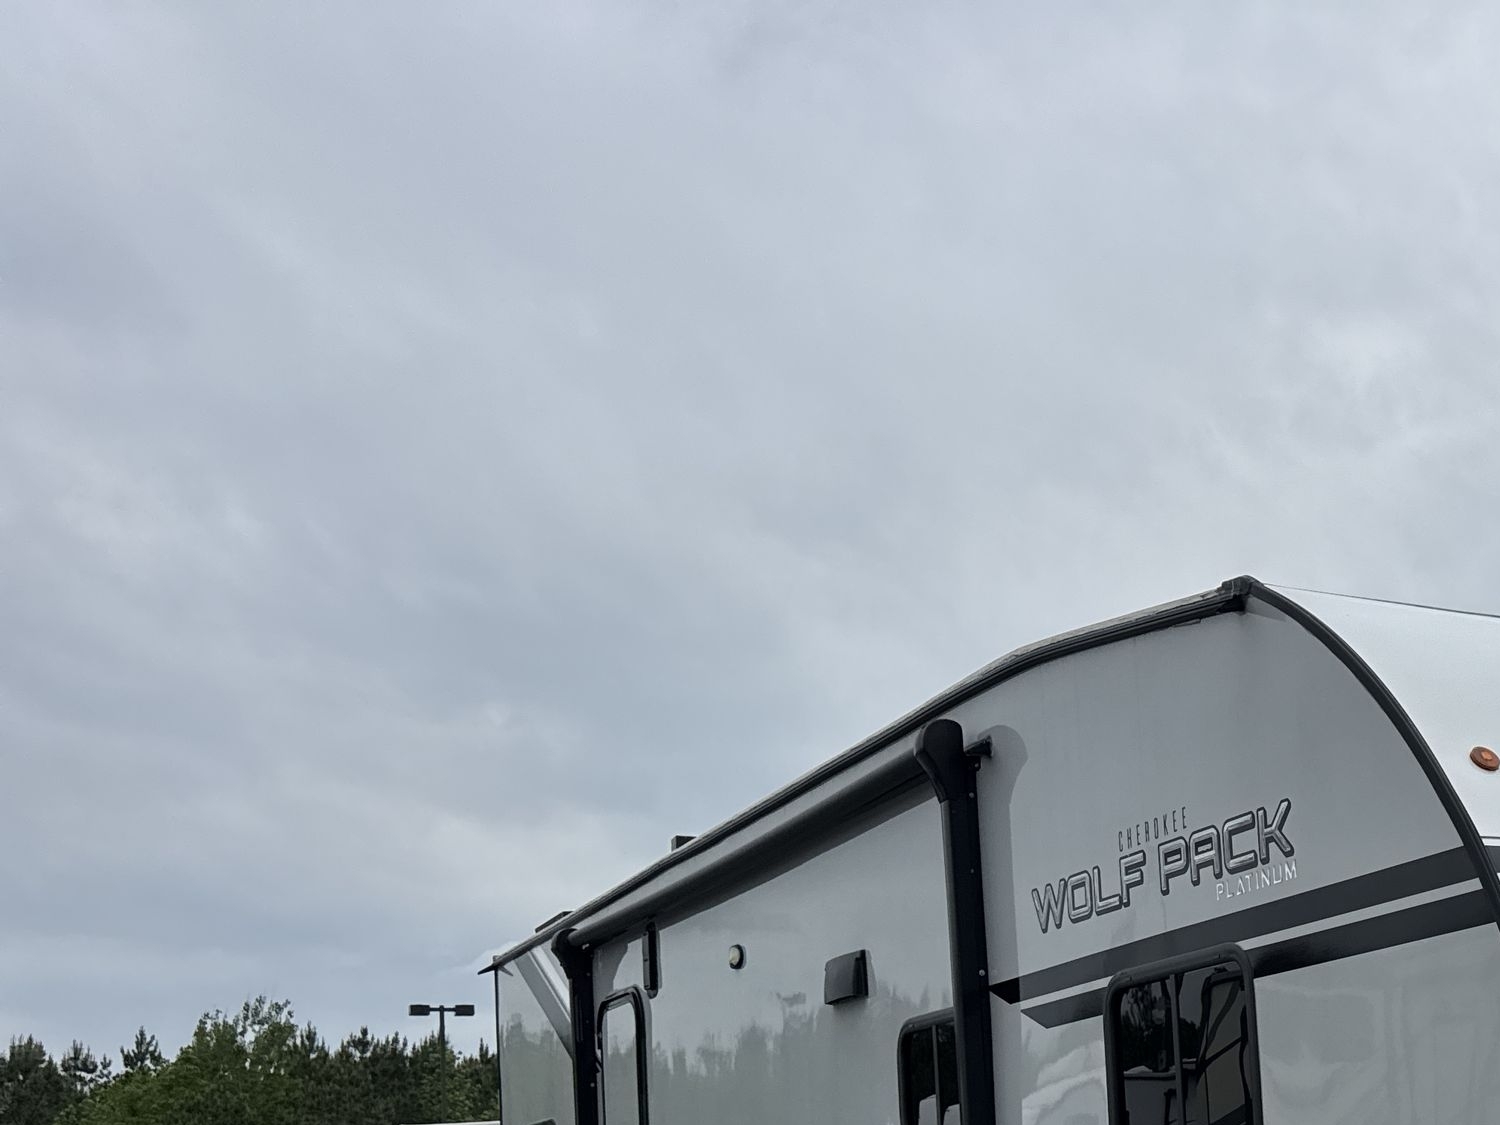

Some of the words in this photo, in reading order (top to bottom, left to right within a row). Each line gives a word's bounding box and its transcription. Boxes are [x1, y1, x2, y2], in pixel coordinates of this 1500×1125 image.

[1118, 806, 1188, 853] CHEROKEE
[1031, 849, 1146, 934] WOLF
[1157, 798, 1295, 896] PACK
[1215, 858, 1298, 902] PLATINUM
